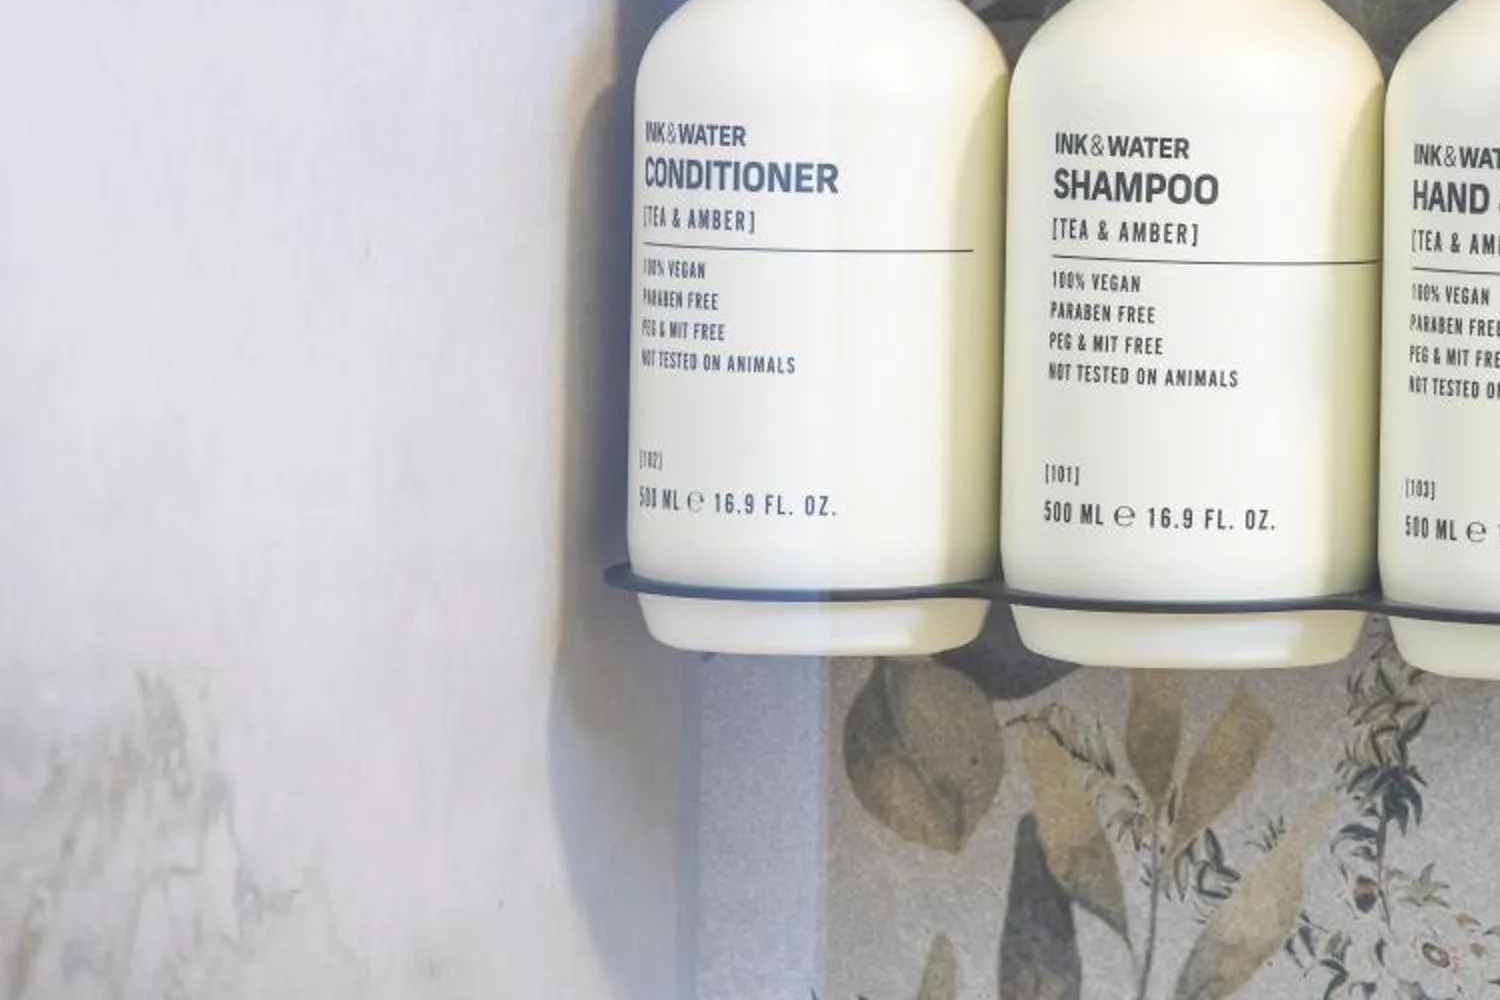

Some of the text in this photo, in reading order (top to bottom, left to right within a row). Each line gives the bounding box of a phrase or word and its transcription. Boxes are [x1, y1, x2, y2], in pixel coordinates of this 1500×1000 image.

[646, 121, 746, 146] INK&WATER
[1055, 132, 1189, 159] INK&WATER
[645, 156, 839, 194] CONDITIONER
[1053, 168, 1218, 205] SHAMPOO
[1413, 180, 1490, 215] HAND
[673, 209, 680, 229] &
[688, 209, 755, 233] AMBER]
[1098, 221, 1108, 241] &
[1119, 221, 1198, 246] AMBER]
[1451, 233, 1460, 254] &
[668, 261, 705, 279] VEGAN
[1092, 274, 1140, 293] VEGAN
[643, 288, 718, 310] PARABEN FREE
[1446, 287, 1490, 306] VEGAN
[1050, 302, 1155, 323] PARABEN FREE
[660, 321, 665, 338] &
[670, 322, 689, 339] MIT
[694, 323, 724, 341] FREE
[1410, 314, 1463, 335] PARABEN
[1078, 335, 1086, 352] &
[1094, 335, 1117, 353] MIT
[1125, 337, 1163, 355] FREE
[659, 352, 697, 370] TESTED
[704, 355, 720, 372] ON
[727, 356, 796, 374] ANIMALS
[1434, 348, 1440, 365] &
[1446, 349, 1469, 367] MIT
[1077, 365, 1128, 384] TESTED
[1137, 368, 1157, 385] ON
[1165, 369, 1238, 387] ANIMALS
[1433, 378, 1479, 398] TESTED
[1045, 464, 1079, 485] [101]
[640, 486, 656, 508] 500
[662, 488, 679, 511] ML
[715, 493, 754, 514] 16.9
[765, 495, 793, 515] FL.
[805, 495, 836, 516] OZ.
[1043, 502, 1071, 523] 500
[1080, 504, 1103, 525] ML
[1149, 507, 1193, 529] 16.9
[1205, 509, 1233, 530] FL.
[1245, 510, 1275, 531] OZ.
[1405, 515, 1428, 538] 500
[1436, 519, 1456, 541] ML
